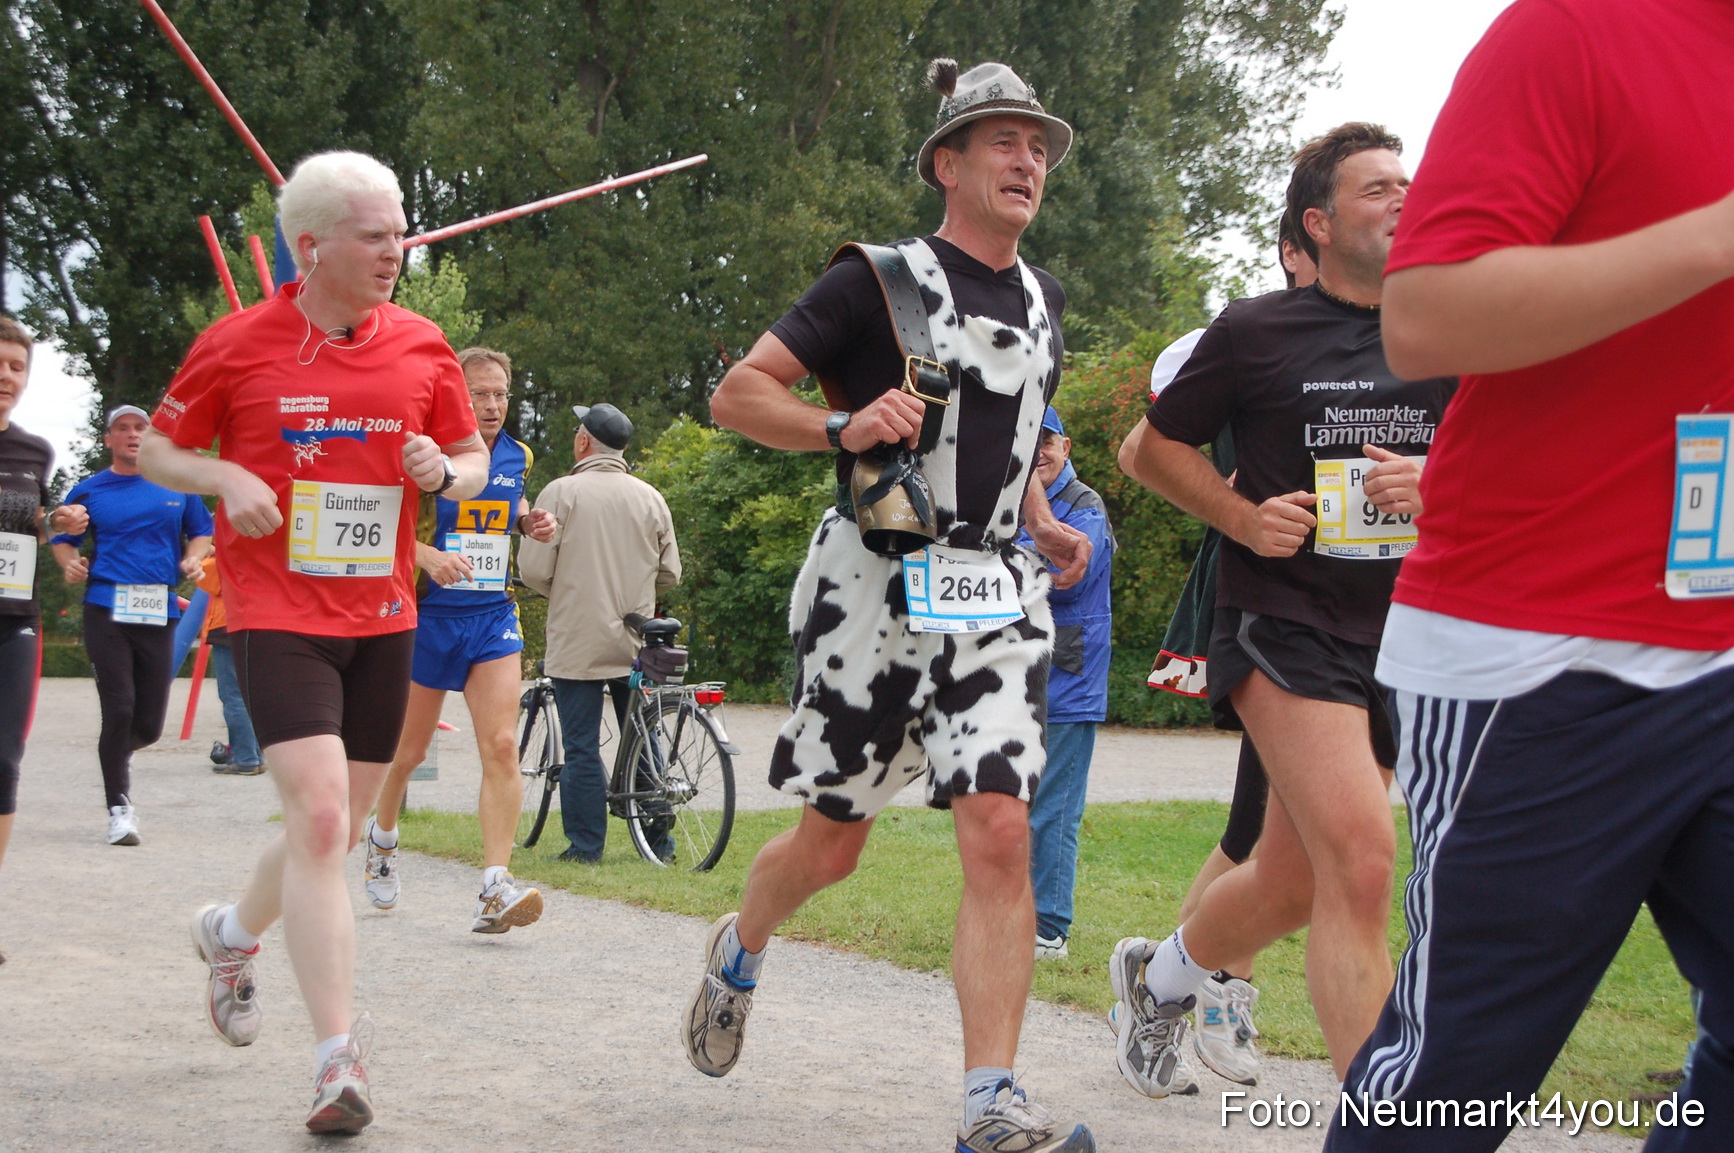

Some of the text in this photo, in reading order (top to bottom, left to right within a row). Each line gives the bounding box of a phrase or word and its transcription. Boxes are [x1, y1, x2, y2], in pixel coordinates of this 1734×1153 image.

[1303, 380, 1375, 393] powered by
[280, 395, 330, 405] Regensburg
[280, 403, 329, 413] Marathon
[1324, 405, 1427, 423] Neumarkter
[304, 417, 403, 433] 28. Mai 2006
[1304, 421, 1435, 447] Lammsbräu
[325, 492, 380, 511] Günther
[1689, 486, 1702, 510] D
[1322, 499, 1330, 512] B
[295, 517, 304, 531] C
[335, 522, 382, 547] 796
[465, 539, 494, 549] Johann
[912, 574, 919, 586] B
[939, 575, 1003, 602] 2641
[132, 596, 163, 610] 2606
